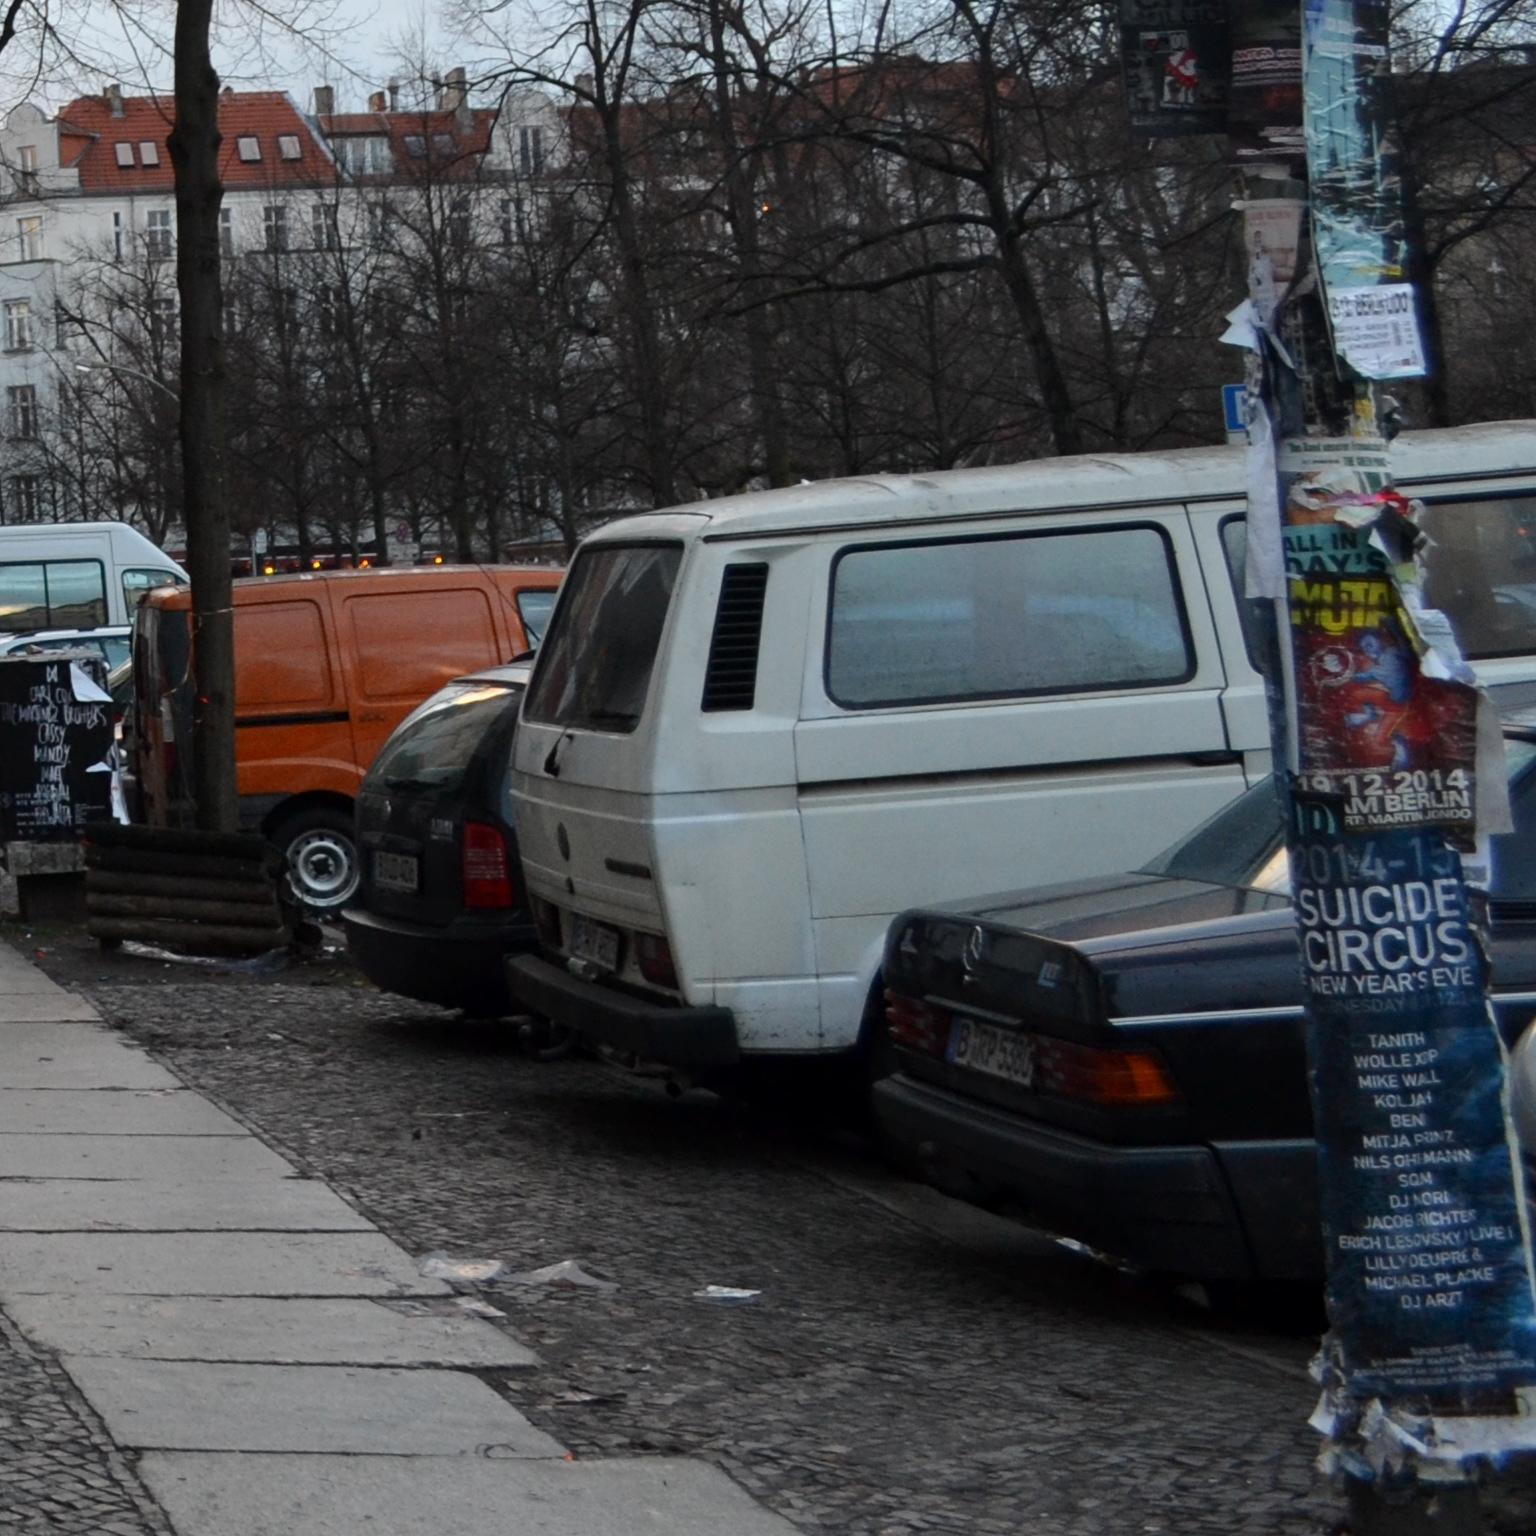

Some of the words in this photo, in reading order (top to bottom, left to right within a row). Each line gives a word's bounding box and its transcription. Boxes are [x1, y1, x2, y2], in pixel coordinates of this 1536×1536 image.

[1332, 532, 1357, 550] IN
[1385, 791, 1469, 812] BERLIN
[1300, 878, 1461, 927] SUICIDE
[1304, 921, 1469, 972] CIRCUS
[1310, 975, 1346, 995] NEW
[1353, 969, 1427, 994] YEAR'S
[1432, 966, 1474, 987] EVE
[1368, 1032, 1425, 1049] TANITH
[1354, 1053, 1411, 1069] WOLLE
[1358, 1074, 1398, 1089] MIKE
[1363, 1134, 1411, 1150] MITJA
[1353, 1154, 1390, 1170] NILS
[1389, 1195, 1409, 1209] DJ
[1364, 1215, 1414, 1231] JACOB
[1339, 1235, 1381, 1250] ERICH
[1401, 1295, 1422, 1309] DJ
